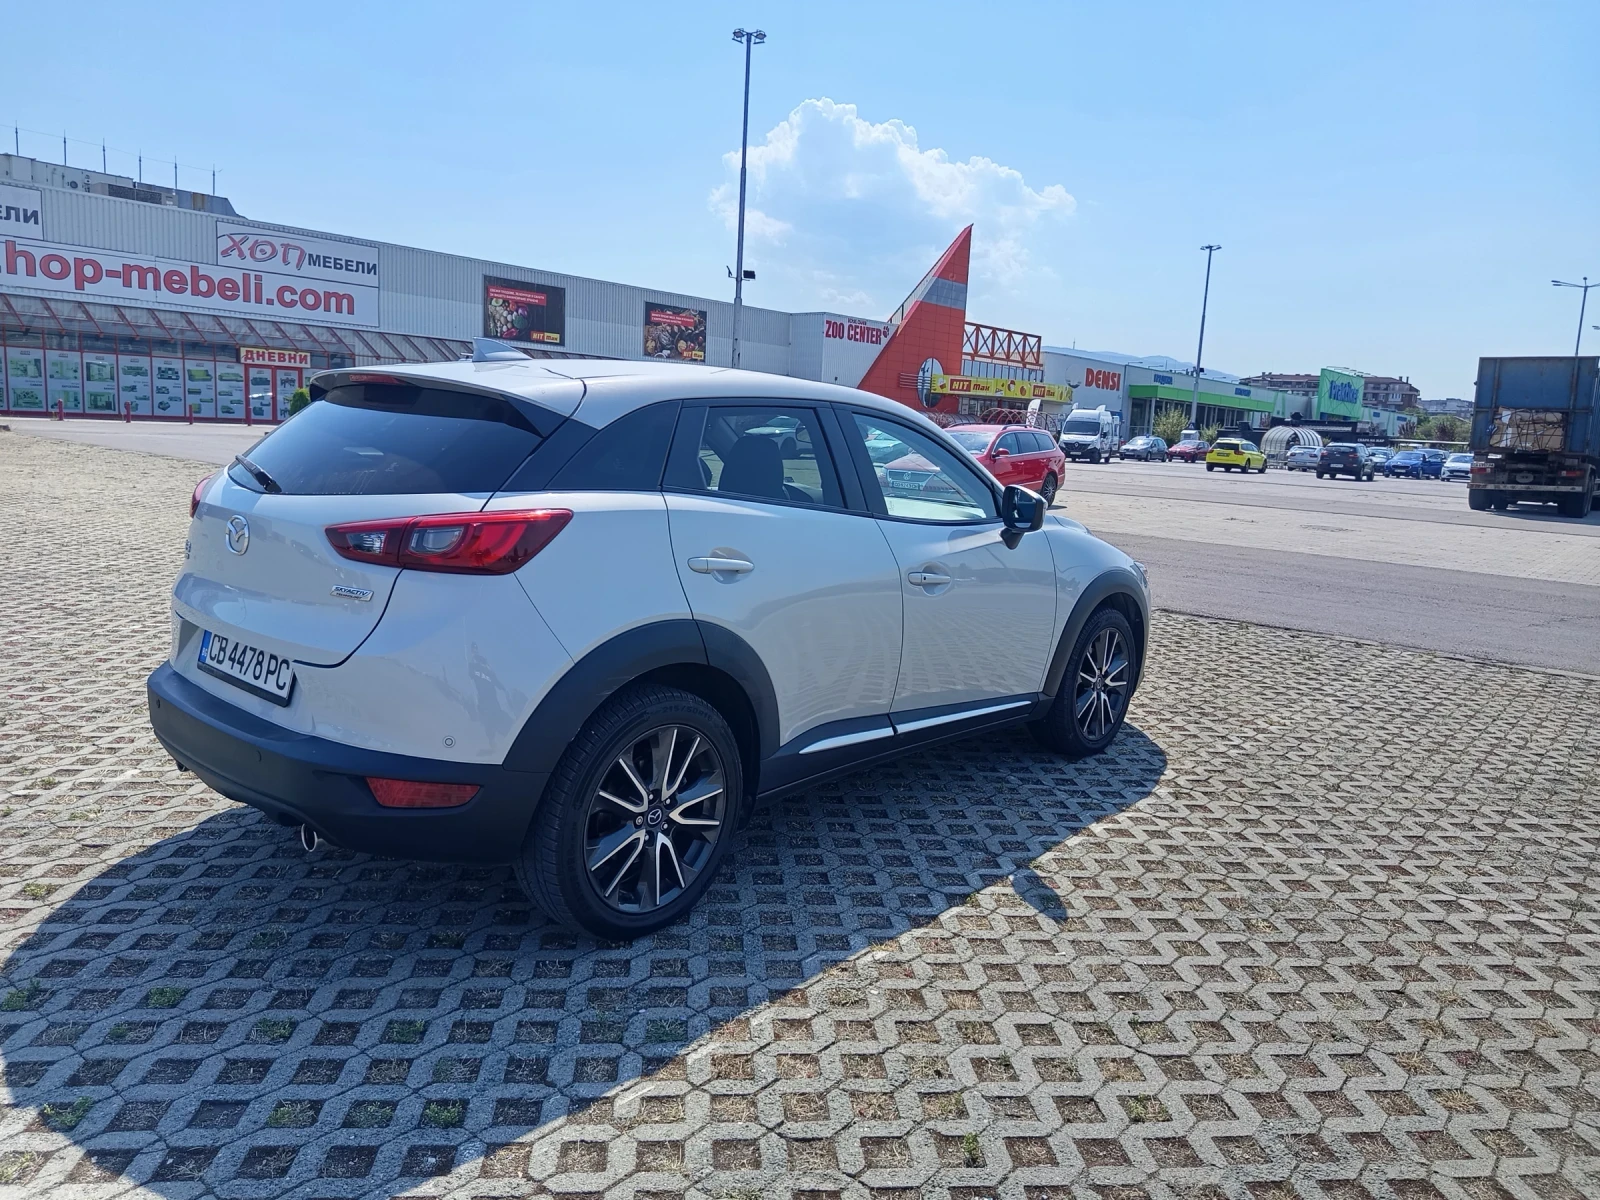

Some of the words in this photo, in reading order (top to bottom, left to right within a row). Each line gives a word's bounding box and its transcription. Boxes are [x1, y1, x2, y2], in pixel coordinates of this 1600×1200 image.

[0, 205, 39, 225] ЛИ
[220, 233, 307, 271] ХОП
[308, 253, 378, 276] МЕБЕЛИ
[0, 239, 355, 316] hop-mebeli.com
[825, 319, 845, 340] ZOO
[847, 324, 882, 345] CENTER
[242, 349, 308, 364] ДНЕВНИ
[952, 381, 969, 390] HIT
[1085, 368, 1121, 391] DENSI
[1035, 387, 1045, 396] HIT
[334, 586, 369, 596] SKYACTIV
